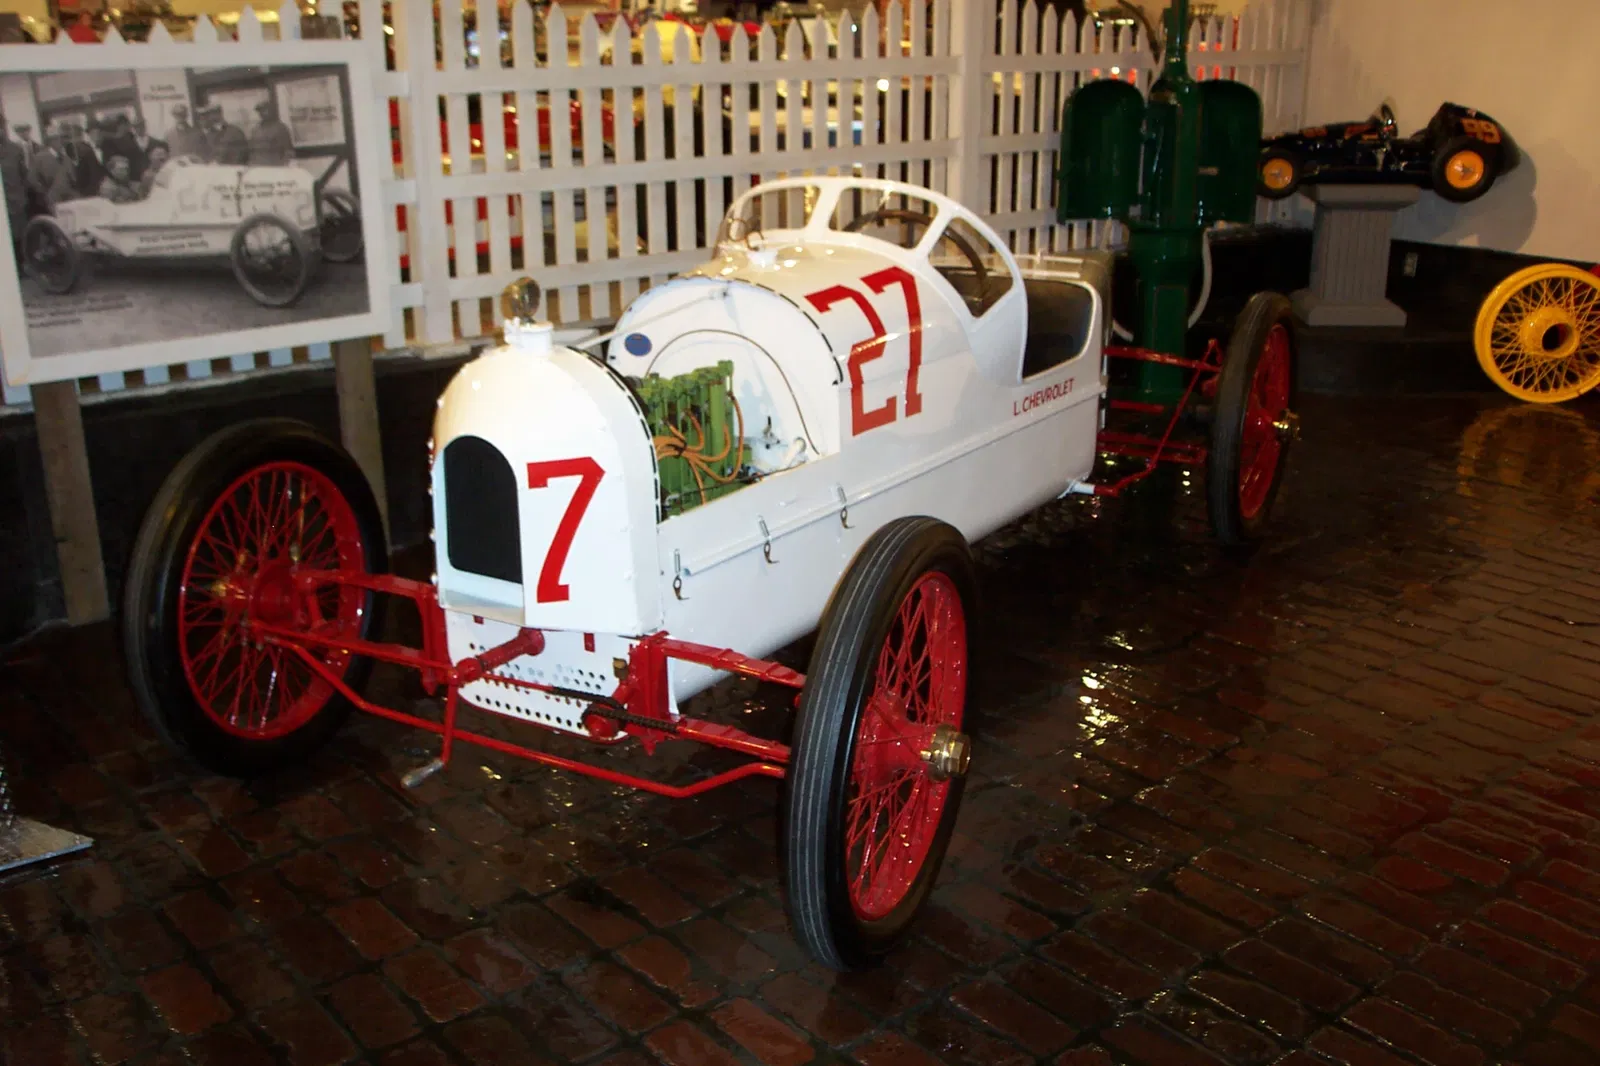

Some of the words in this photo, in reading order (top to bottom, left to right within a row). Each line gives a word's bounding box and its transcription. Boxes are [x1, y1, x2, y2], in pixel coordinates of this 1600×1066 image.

[805, 265, 922, 435] 27
[1023, 378, 1075, 412] CHEVROLET
[527, 456, 605, 603] 7
